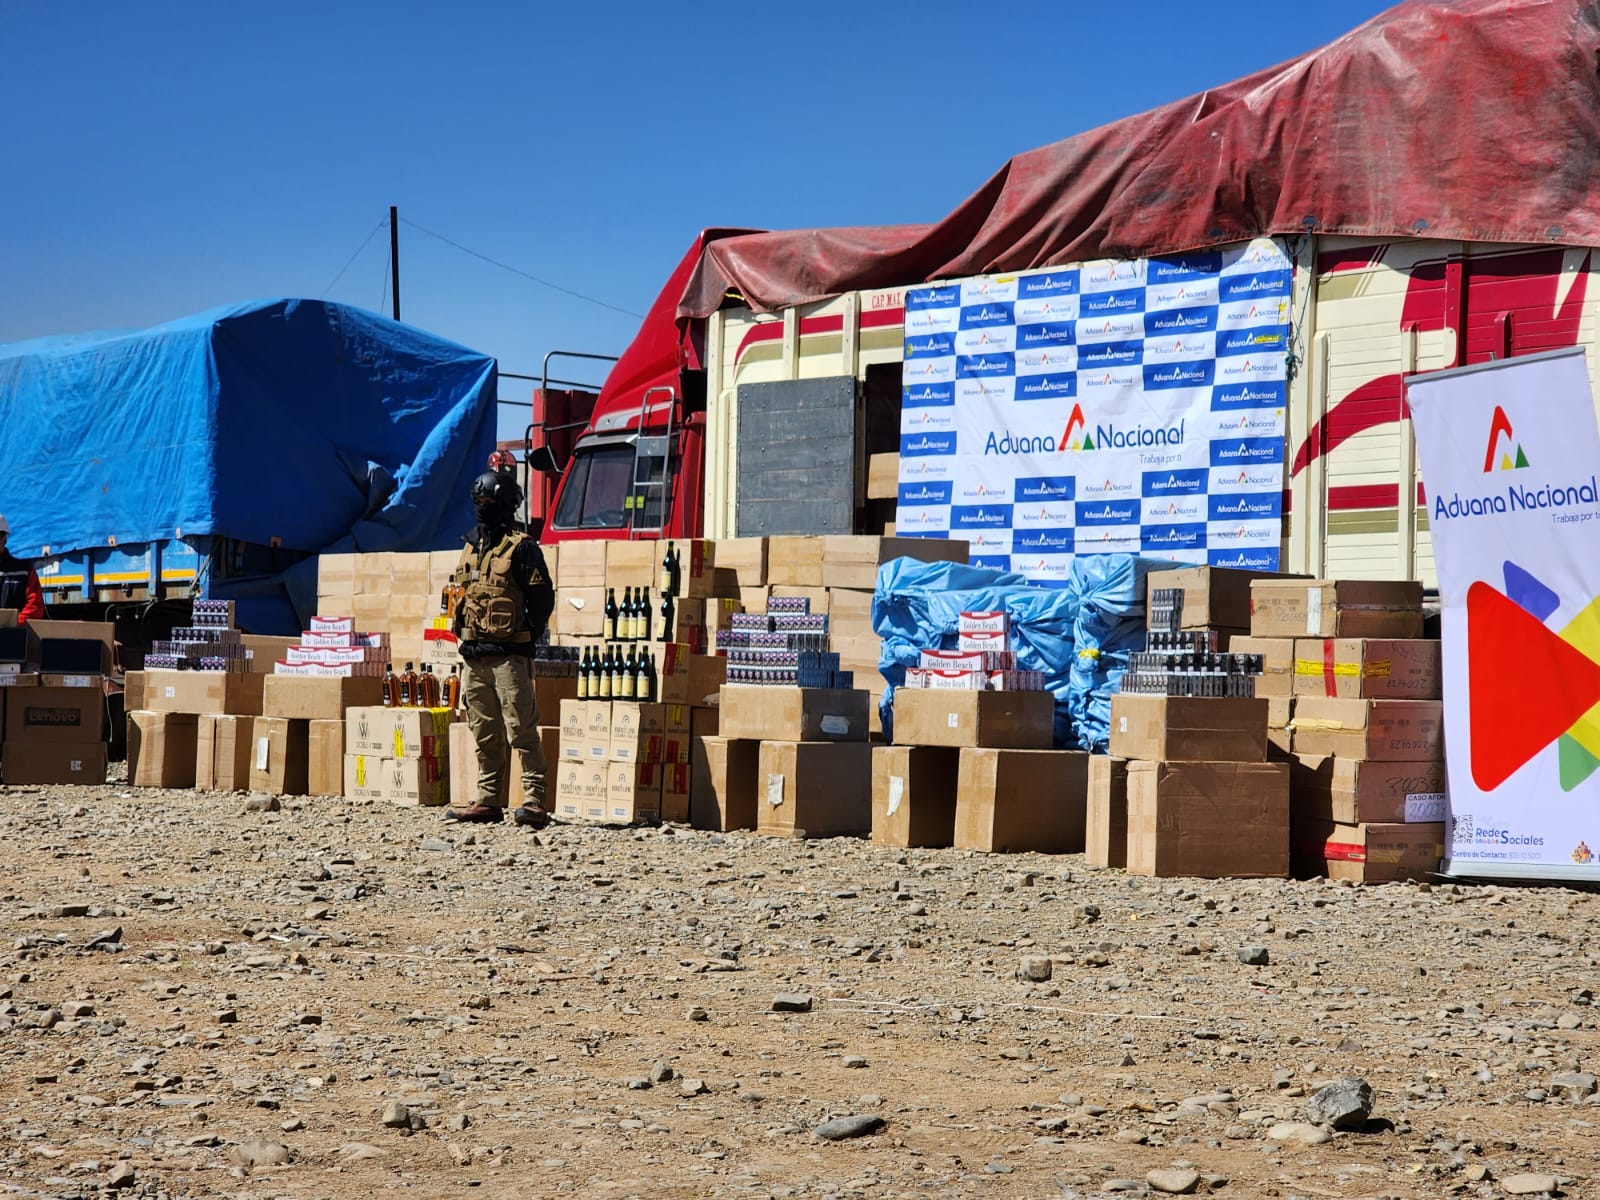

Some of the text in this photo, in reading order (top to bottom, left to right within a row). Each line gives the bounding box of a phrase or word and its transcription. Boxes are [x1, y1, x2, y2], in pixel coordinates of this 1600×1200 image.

[1158, 267, 1179, 275] Aduana
[1230, 280, 1283, 294] Aduana Nacional
[1184, 290, 1207, 298] Nacional
[1089, 297, 1136, 310] Aduana Nacional
[1227, 312, 1248, 320] Aduana
[1155, 316, 1207, 328] Aduana Nacional
[1112, 324, 1133, 332] Nacional
[1227, 340, 1246, 348] Aduana
[1224, 364, 1277, 374] Aduana Nacional
[1154, 370, 1204, 381] Aduana Nacional
[1221, 391, 1276, 402] Aduana Nacional
[1219, 420, 1275, 430] Aduana Nacional
[985, 418, 1184, 455] Aduana Nacional
[1219, 450, 1238, 458] Aduana
[1165, 455, 1176, 464] por
[1177, 479, 1199, 487] Nacional
[1249, 475, 1273, 483] Nacional
[1435, 475, 1598, 520] Aduana Nacional
[1177, 506, 1197, 514] Nacional
[1217, 502, 1272, 513] Aduana Nacional
[1111, 510, 1131, 518] Nacional
[1552, 513, 1579, 524] Trabaja
[1581, 513, 1592, 522] por
[1246, 557, 1269, 565] Nacional
[964, 641, 998, 649] Golden Beach
[928, 659, 973, 669] Golden Beach
[30, 710, 77, 722] Lenovo
[1500, 830, 1544, 846] Sociales
[1472, 850, 1479, 858] de
